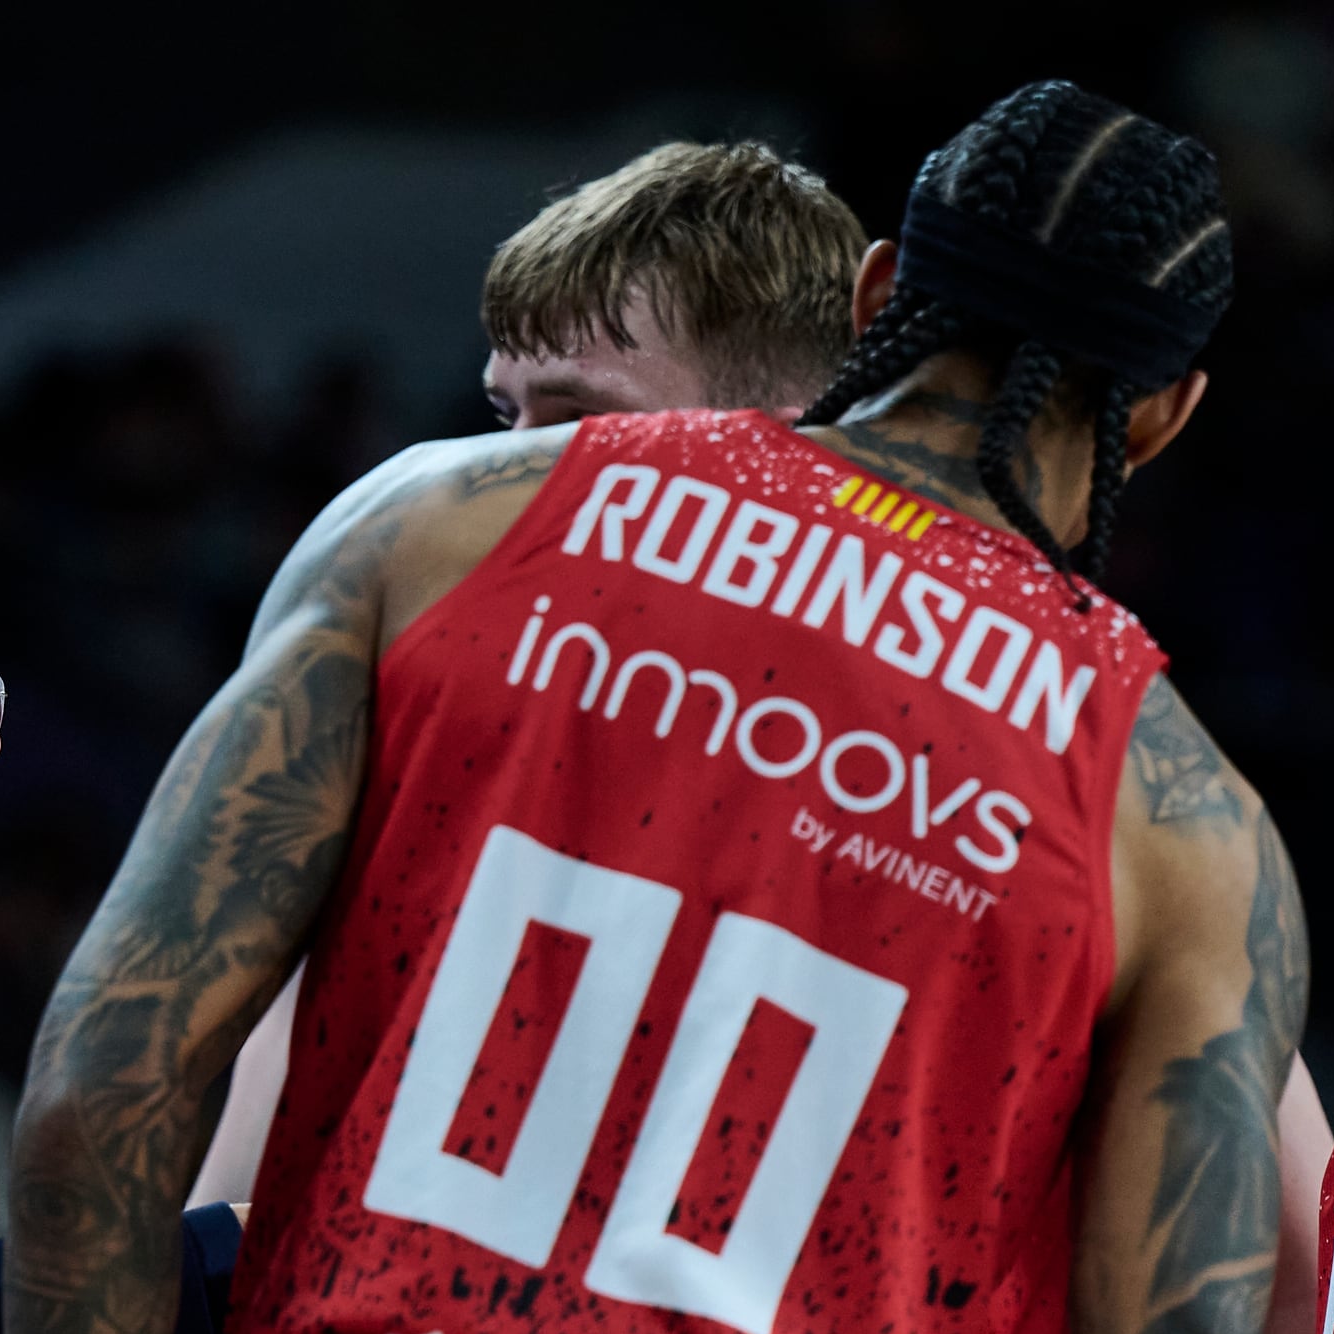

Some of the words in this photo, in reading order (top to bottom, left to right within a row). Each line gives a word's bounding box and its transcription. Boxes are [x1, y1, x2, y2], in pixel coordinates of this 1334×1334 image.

[507, 594, 1034, 874] inmoovs
[561, 463, 1097, 756] ROBINSON
[790, 806, 833, 853] by
[837, 832, 998, 922] AVINENT
